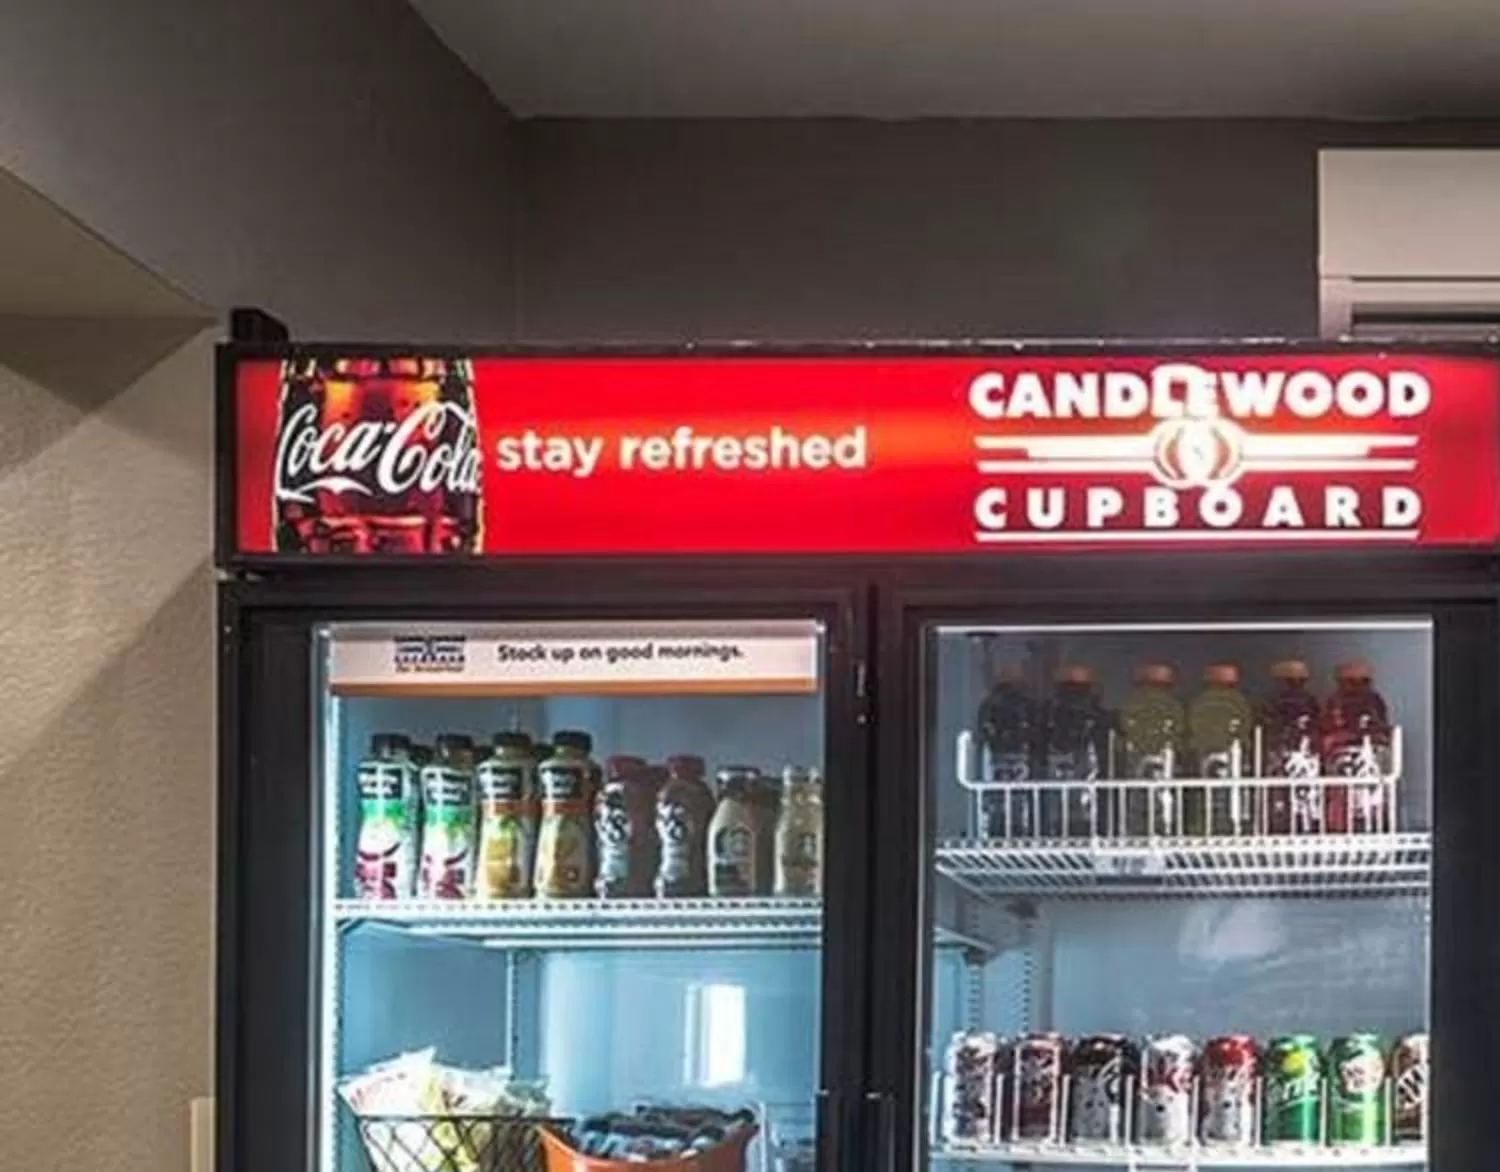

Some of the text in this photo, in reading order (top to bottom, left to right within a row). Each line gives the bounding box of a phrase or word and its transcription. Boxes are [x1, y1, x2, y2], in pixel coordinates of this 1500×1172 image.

[969, 363, 1431, 418] CANDLEWOOD
[274, 400, 867, 503] Coca-Cola stay refreshed
[974, 486, 1422, 529] CUPBOARD
[497, 642, 744, 664] Stock up on good mornings.
